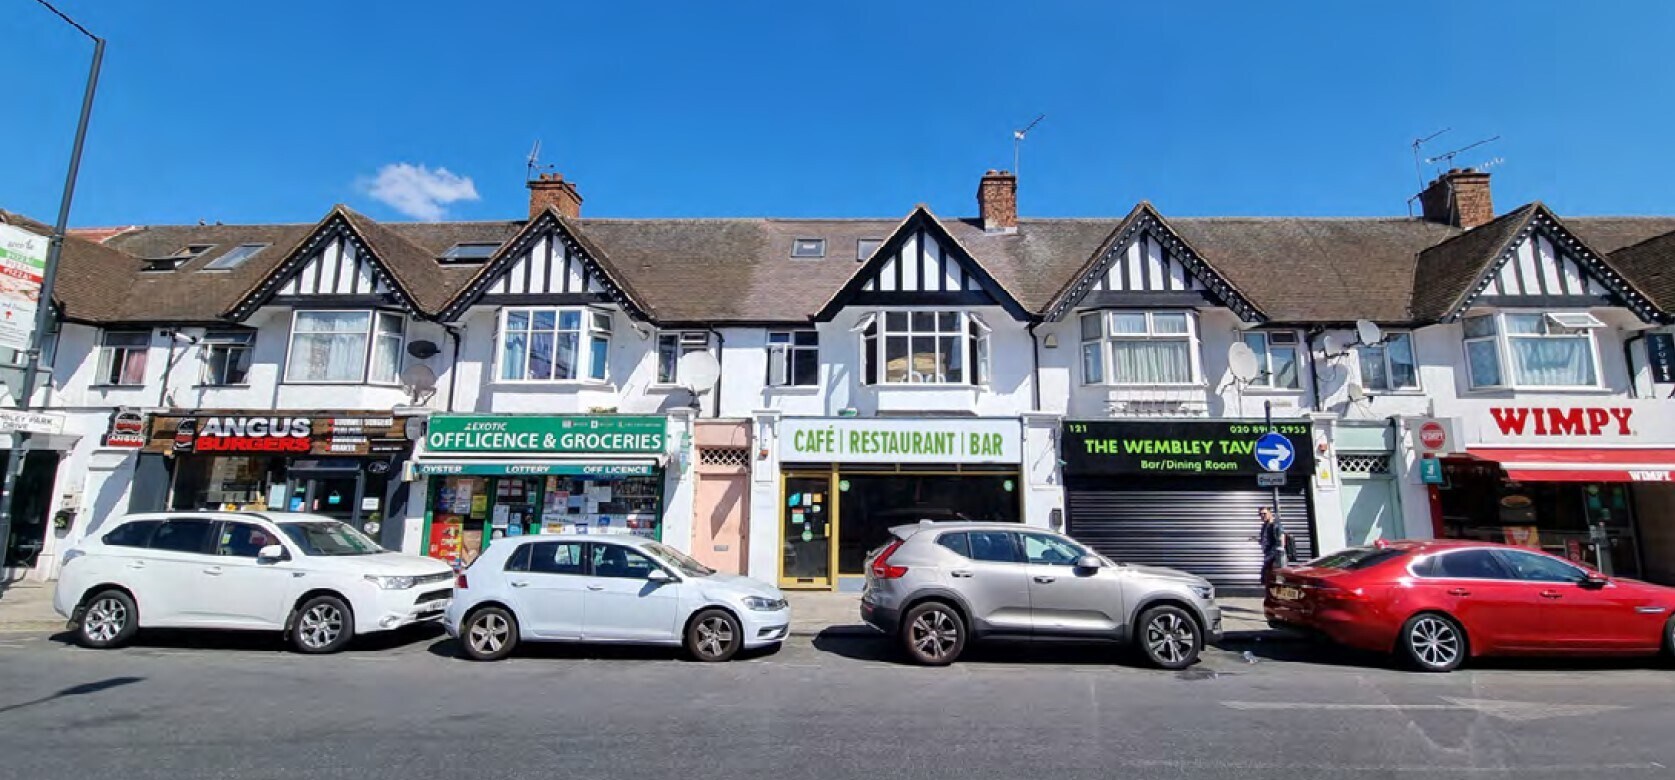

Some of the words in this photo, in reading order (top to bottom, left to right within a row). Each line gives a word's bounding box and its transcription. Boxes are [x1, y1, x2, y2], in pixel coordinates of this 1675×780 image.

[199, 416, 311, 438] ANGUS
[472, 422, 508, 431] EXOTIC
[1069, 424, 1088, 434] 121
[1489, 407, 1633, 436] WIMPY
[197, 436, 311, 451] BURGERS
[430, 432, 539, 448] OFFLICENCE
[543, 432, 556, 448] &
[561, 433, 662, 449] GROCERIES
[794, 425, 835, 453] CAFÉ
[850, 430, 956, 455] RESTAURANT
[969, 432, 1004, 456] BAR
[1084, 439, 1119, 454] THE
[1123, 439, 1214, 455] WEMBLEY
[1219, 439, 1255, 455] TAV
[422, 465, 463, 474] OYSTER
[505, 465, 551, 474] LOTTERY
[583, 466, 603, 474] OFF
[605, 466, 649, 474] LICENCE
[1140, 460, 1202, 473] Bar/Dining
[1205, 460, 1238, 471] Room
[1628, 470, 1672, 481] WIMPY
